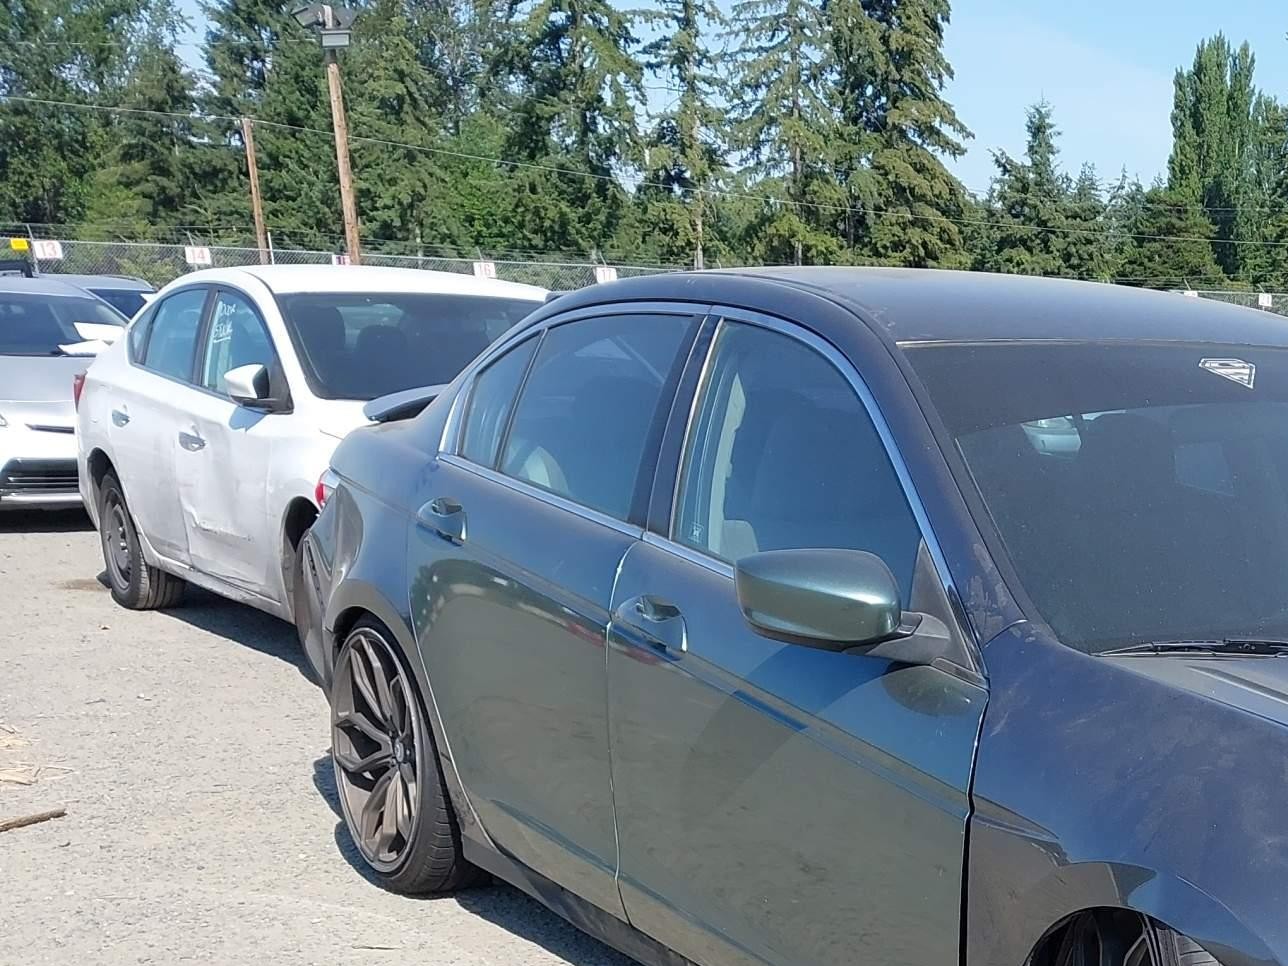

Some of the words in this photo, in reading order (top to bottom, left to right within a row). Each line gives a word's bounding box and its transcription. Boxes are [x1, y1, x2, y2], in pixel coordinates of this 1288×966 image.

[40, 242, 57, 256] 13
[191, 248, 205, 261] 14
[478, 263, 491, 276] 16
